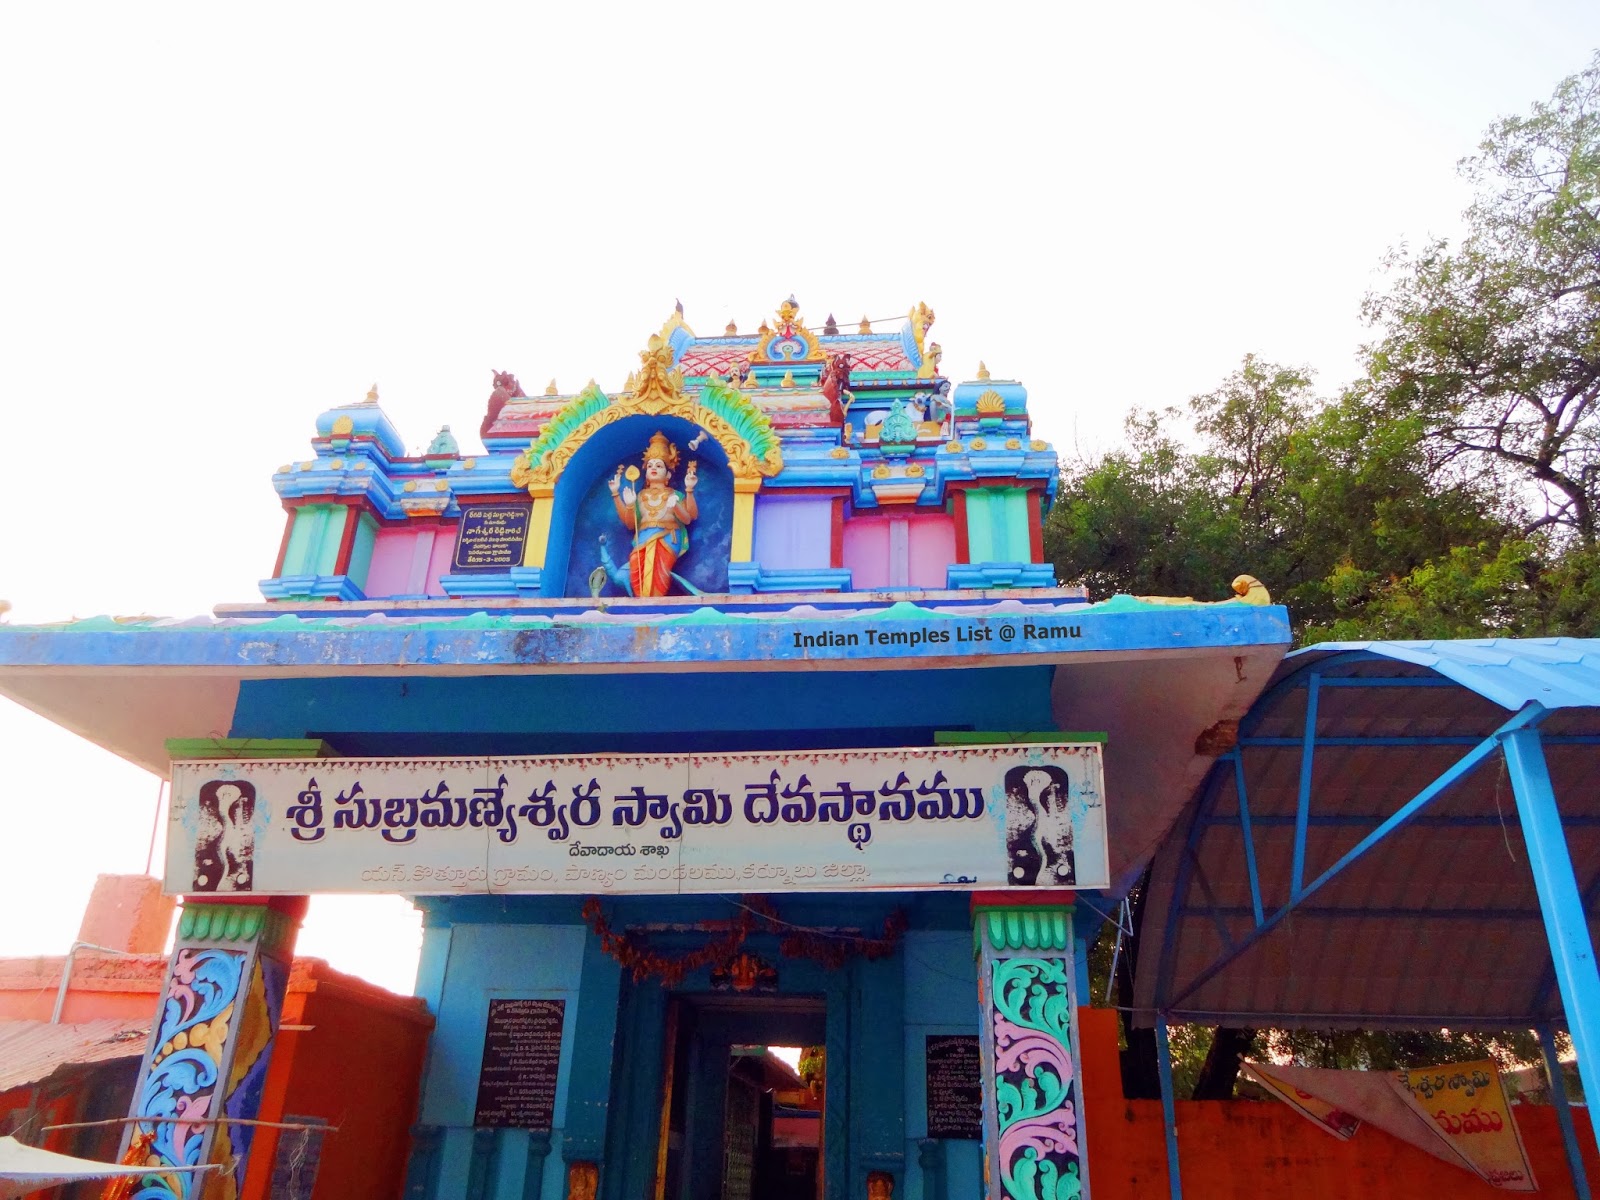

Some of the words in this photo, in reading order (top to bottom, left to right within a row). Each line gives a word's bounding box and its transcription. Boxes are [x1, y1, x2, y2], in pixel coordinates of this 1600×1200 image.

[286, 777, 325, 842] శ్రీ
[333, 773, 601, 843] సుబ్రమణ్యేశ్వర
[612, 783, 733, 840] స్వామి
[743, 769, 985, 850] దేవస్థానము
[569, 842, 636, 858] దేవాదాయ
[640, 842, 670, 859] శాఖ
